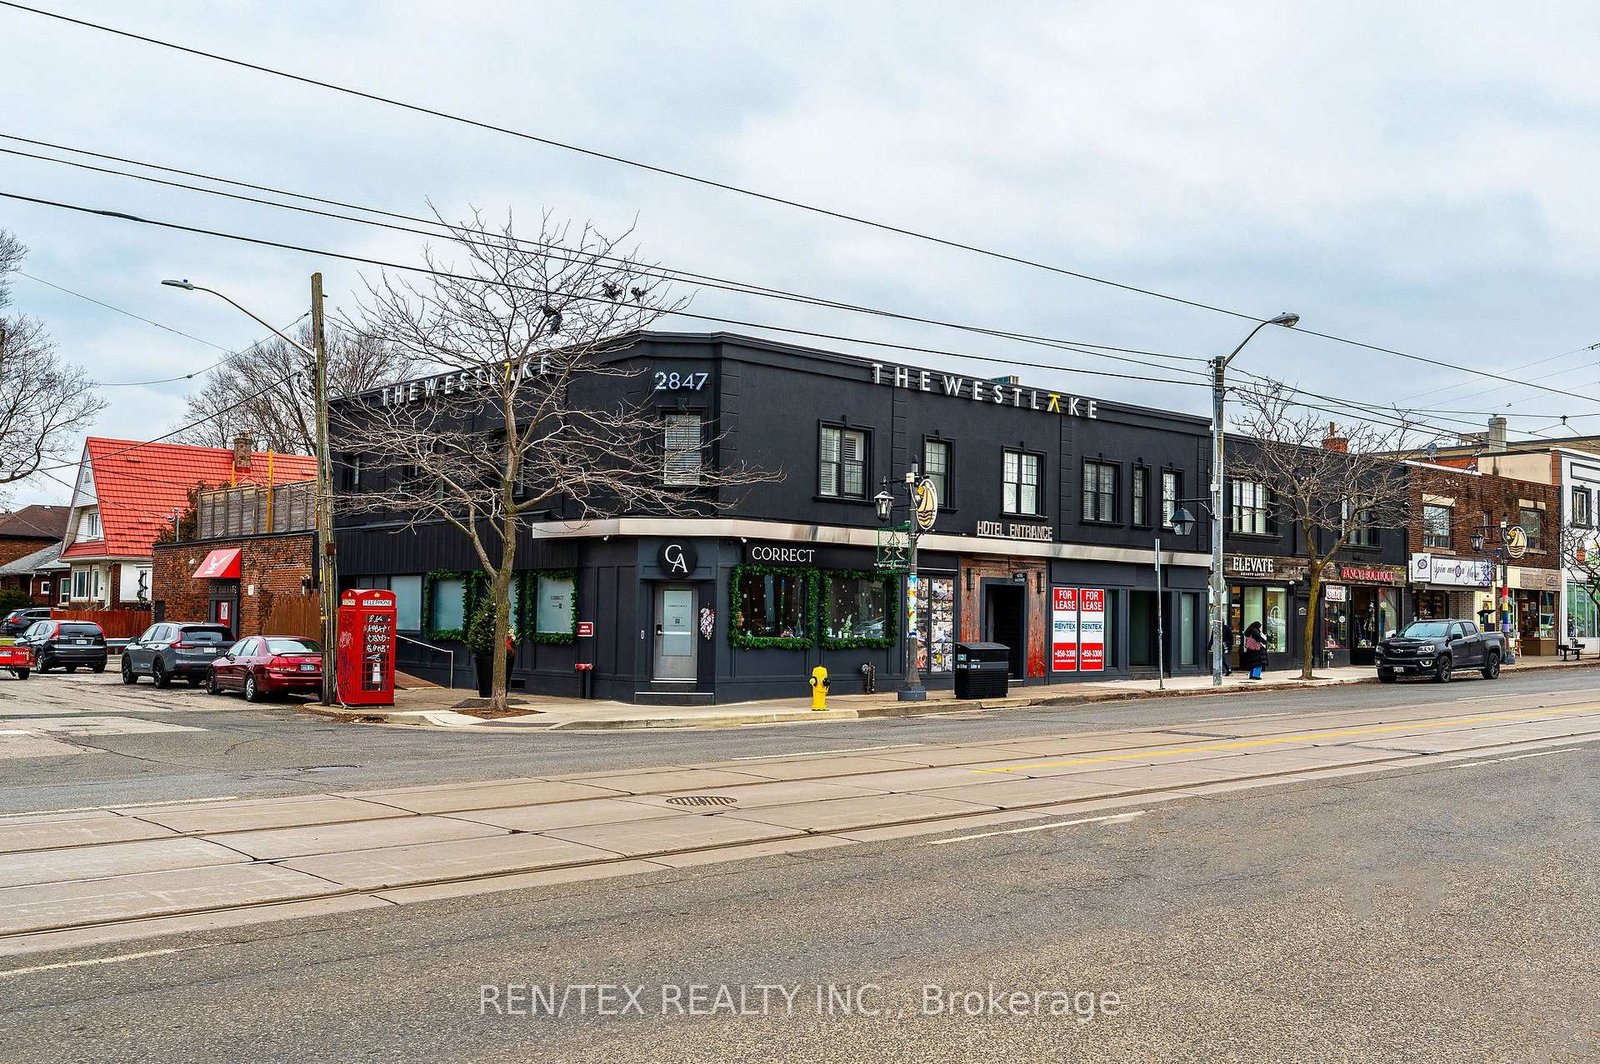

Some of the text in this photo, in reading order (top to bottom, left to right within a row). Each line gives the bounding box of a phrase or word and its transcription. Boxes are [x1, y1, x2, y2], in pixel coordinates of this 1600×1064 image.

[655, 371, 709, 391] 2847
[977, 521, 1053, 540] HOTEL ENTRANCE
[752, 546, 816, 563] CORRECT
[1233, 557, 1274, 573] ELEVATE
[1059, 590, 1072, 600] FOR
[1086, 591, 1099, 600] FOR
[1055, 601, 1075, 610] LEASE
[1082, 602, 1102, 611] LEASE
